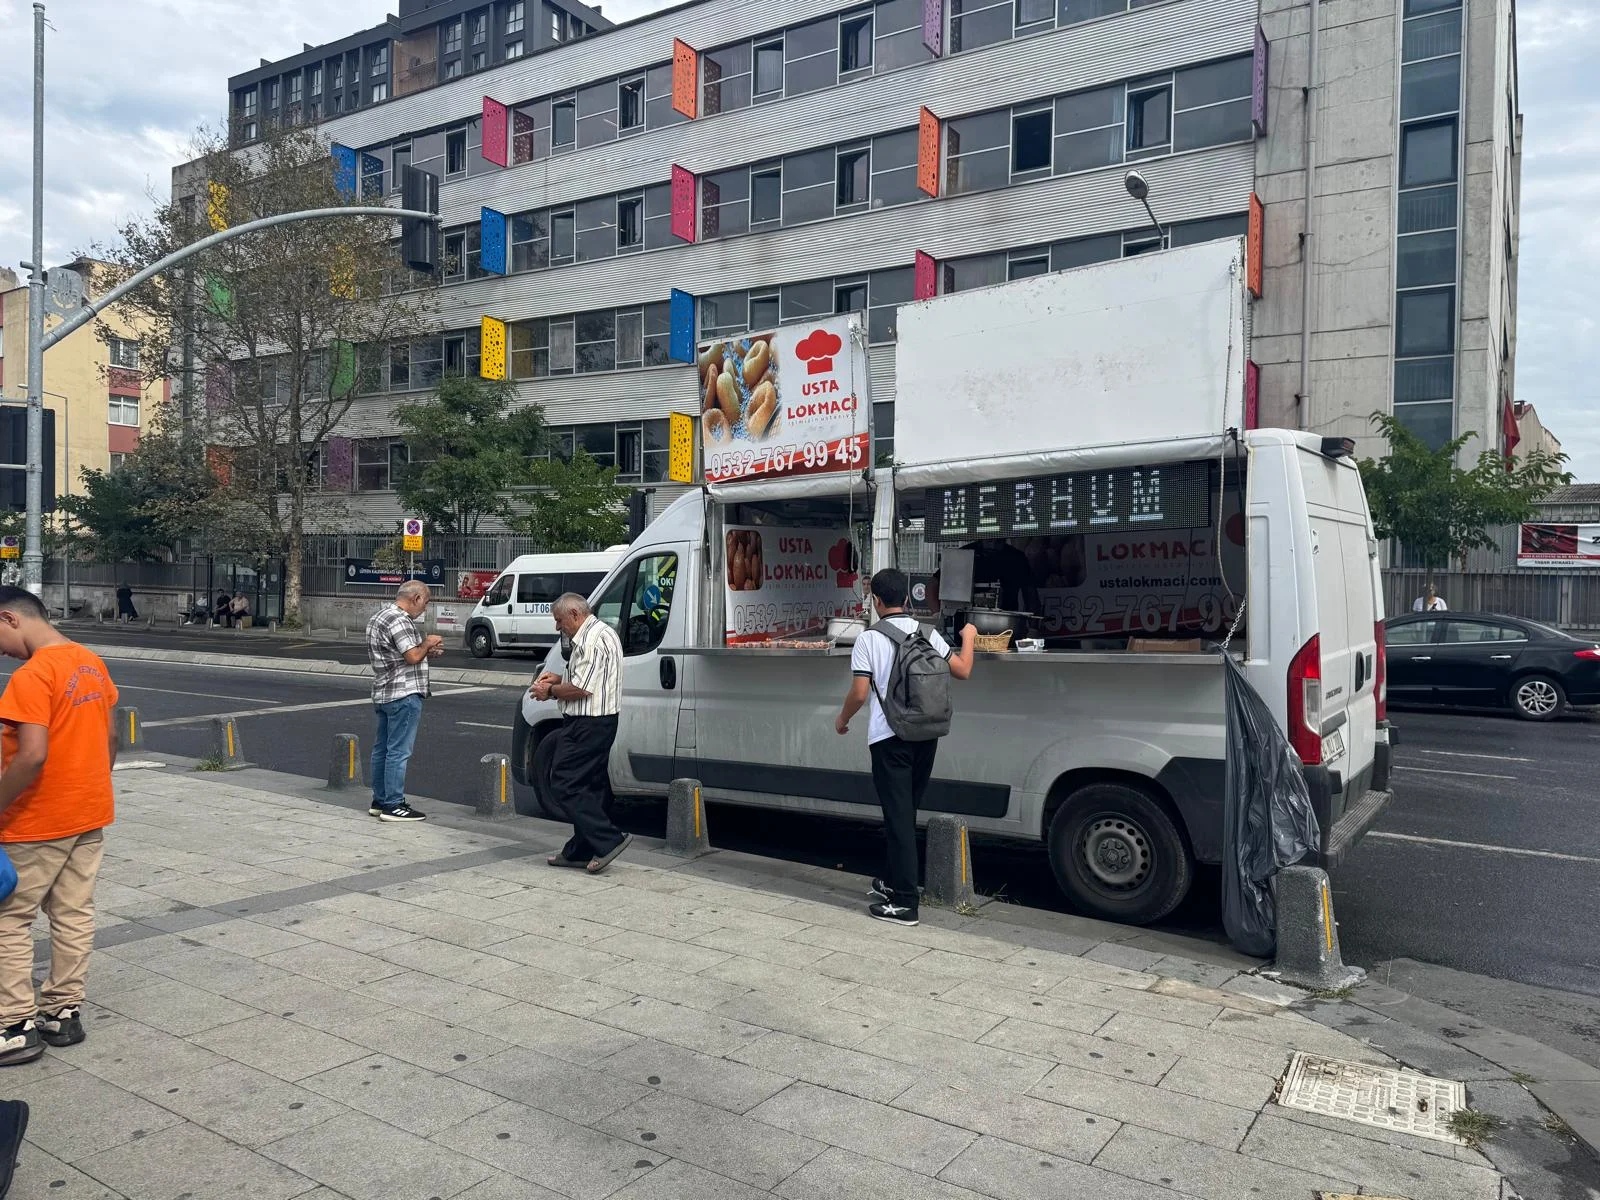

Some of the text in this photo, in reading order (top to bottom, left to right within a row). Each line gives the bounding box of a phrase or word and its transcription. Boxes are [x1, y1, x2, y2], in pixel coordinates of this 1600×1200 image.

[802, 379, 839, 396] USTA
[711, 436, 862, 479] 0532 767 99 45
[779, 537, 813, 554] USTA
[764, 564, 828, 581] LOKMACI
[1099, 573, 1222, 589] ustalokmaci.com
[733, 602, 778, 636] 0532
[781, 601, 813, 632] 767
[1042, 595, 1105, 633] 532
[1115, 593, 1185, 633] 767
